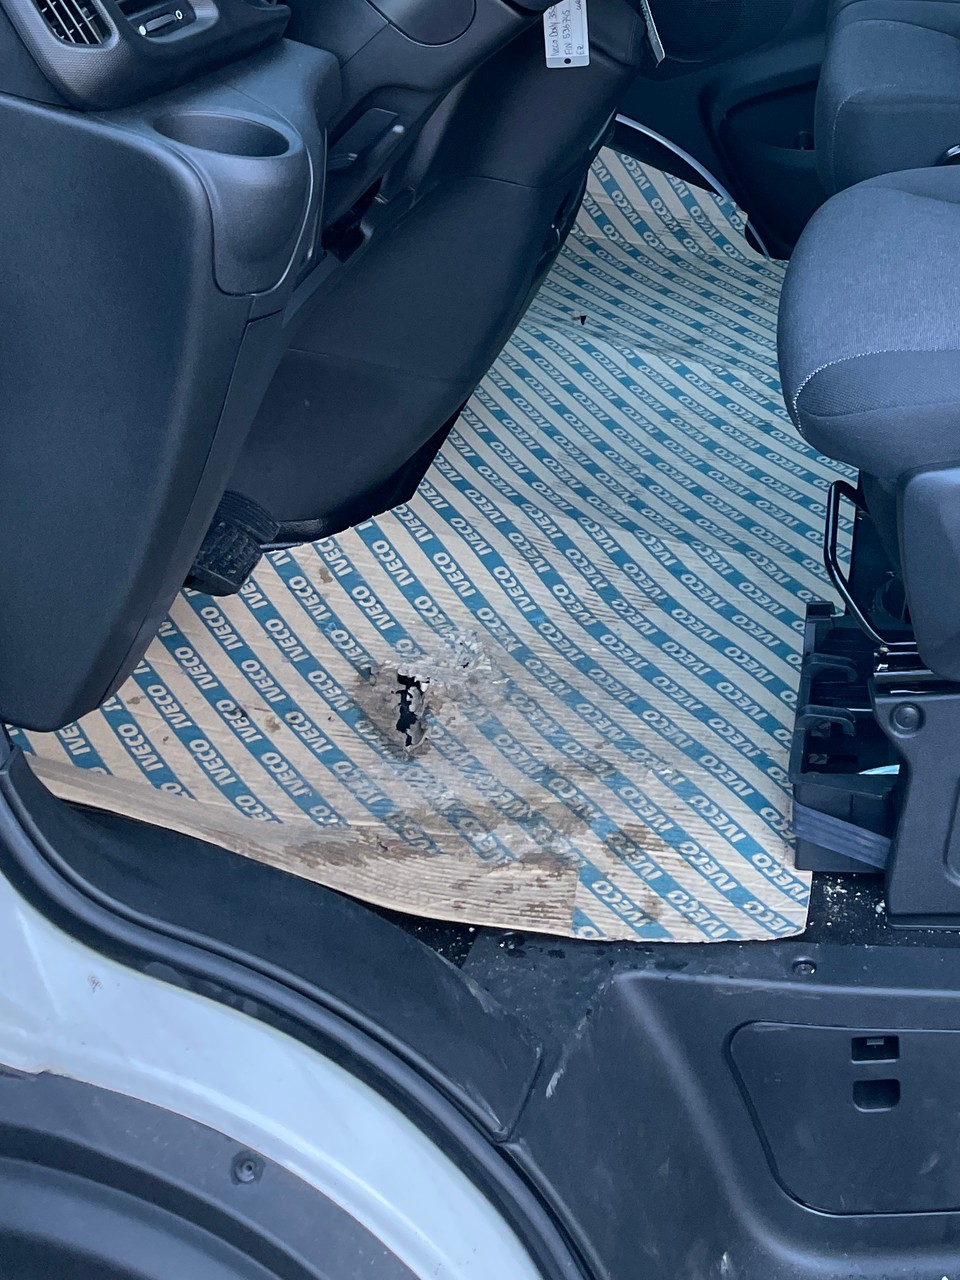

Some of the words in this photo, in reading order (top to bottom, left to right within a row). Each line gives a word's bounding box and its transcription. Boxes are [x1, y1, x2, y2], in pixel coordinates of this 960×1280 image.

[620, 153, 651, 190] IVECO
[611, 190, 641, 225] IVECO
[603, 224, 634, 251] IVECO
[643, 231, 674, 257] IVECO
[544, 340, 580, 366] IVECO
[591, 352, 627, 379] IVECO
[535, 358, 570, 386] IVECO
[582, 372, 619, 400] IVECO
[638, 365, 675, 390] IVECO
[685, 374, 722, 398] IVECO
[524, 377, 561, 405] IVECO
[573, 392, 610, 422] IVECO
[630, 385, 667, 412] IVECO
[461, 408, 488, 433] IVEC
[514, 397, 551, 428] IVECO
[621, 407, 659, 434] IVECO
[678, 396, 716, 420] IVECO
[726, 403, 765, 426] IVECO
[502, 418, 541, 451] IVECO
[564, 413, 602, 444] IVECO
[613, 428, 652, 456] IVECO
[670, 418, 709, 442] IVECO
[721, 425, 760, 448] IVECO
[771, 431, 810, 453] IVECO
[490, 441, 529, 475] IVECO
[554, 435, 593, 466] IVECO
[605, 450, 645, 479] IVECO
[663, 440, 703, 466] IVECO
[714, 448, 755, 472] IVECO
[816, 455, 858, 478] IVECO
[478, 464, 518, 497] IVECO
[543, 457, 583, 489] IVECO
[596, 472, 637, 502] IVECO
[656, 462, 697, 489] IVECO
[708, 471, 750, 495] IVECO
[760, 476, 803, 500] IVECO
[464, 489, 506, 523] IVECO
[532, 480, 574, 511] IVECO
[587, 495, 629, 524] IVECO
[649, 485, 691, 513] IVECO
[702, 494, 745, 521] IVECO
[521, 504, 563, 539] IVECO
[641, 508, 685, 536] IVECO
[755, 500, 799, 526] IVECO
[450, 517, 492, 556] IVECO
[578, 517, 620, 553] IVECO
[634, 530, 677, 566] IVECO
[696, 518, 740, 546] IVECO
[750, 526, 795, 554] IVECO
[317, 539, 353, 577] IVEC
[372, 540, 415, 586] IVECO
[508, 533, 550, 573] IVECO
[565, 549, 608, 589] IVECO
[691, 541, 734, 575] IVECO
[746, 552, 791, 583] IVECO
[433, 552, 476, 597] IVECO
[493, 566, 536, 612] IVECO
[623, 563, 667, 599] IVECO
[241, 581, 268, 609] IVE
[289, 576, 332, 620] IVECO
[352, 586, 396, 630] IVECO
[681, 574, 726, 609] IVECO
[738, 582, 786, 615] IVECO
[200, 607, 243, 650] IVECO
[612, 598, 658, 634] IVECO
[671, 608, 719, 641] IVECO
[732, 615, 780, 647] IVECO
[265, 619, 309, 662] IVECO
[330, 629, 372, 671] VECO
[600, 634, 648, 669] IVECO
[174, 647, 218, 690] IVECO
[662, 642, 711, 675] IVECO
[724, 647, 774, 682] IVECO
[241, 660, 286, 702] IVECO
[308, 670, 354, 711] IVECO
[588, 668, 638, 703] IVECO
[652, 676, 703, 710] IVECO
[147, 685, 192, 729] IVECO
[716, 682, 768, 721] IVECO
[216, 700, 262, 743] IVECO
[284, 711, 332, 753] IVECO
[642, 710, 694, 748] IVECO
[708, 718, 761, 757] IVECO
[58, 721, 90, 756] IVE
[117, 723, 164, 771] IVECO
[188, 739, 237, 785] IVECO
[260, 753, 309, 797] IVECO
[699, 755, 754, 797] IVECO
[622, 787, 676, 831] IVECO
[688, 795, 746, 842] IVECO
[677, 841, 738, 892] IVECO
[592, 881, 651, 927] IVECO
[668, 890, 728, 938] IVECO
[743, 900, 797, 937] VECO
